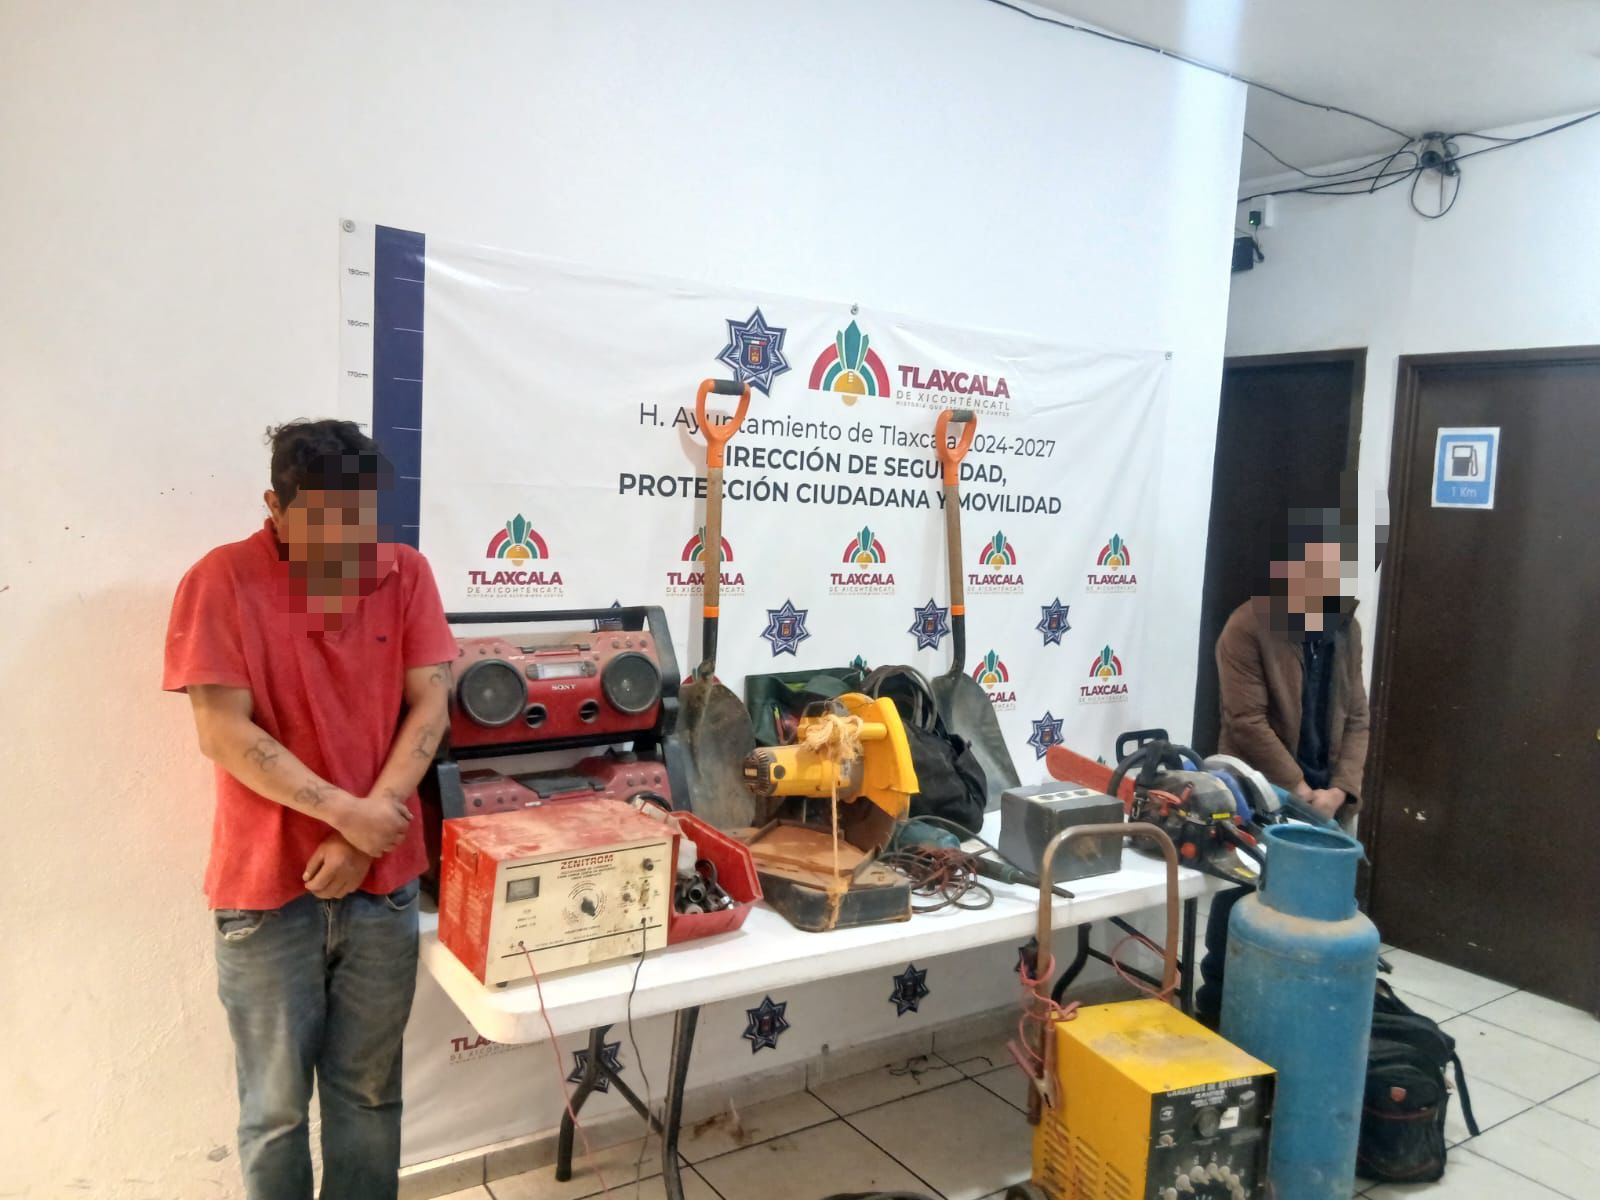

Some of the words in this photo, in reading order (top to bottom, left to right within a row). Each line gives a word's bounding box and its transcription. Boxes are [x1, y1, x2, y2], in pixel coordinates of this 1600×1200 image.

[898, 365, 1010, 399] TLAXCALA
[896, 390, 912, 400] DE
[918, 393, 1010, 411] XICOHTÉNCATL
[640, 403, 664, 426] H.
[848, 422, 873, 443] de
[880, 425, 957, 450] Tlaxcaa
[968, 434, 1056, 458] 024-2027
[706, 446, 841, 473] IRECCIÓN
[848, 454, 878, 475] DE
[884, 457, 1007, 487] SEGUDAD,
[619, 473, 788, 503] PROTECIÓN
[796, 483, 930, 509] CIUDADANA
[468, 571, 563, 585] TLAXCALA
[667, 572, 745, 586] TLAXALA
[830, 573, 895, 585] TLAXCALA
[968, 574, 1024, 585] TLAXCALA
[1087, 574, 1137, 585] TLAXCALA
[1080, 683, 1128, 697] TLAXCALA
